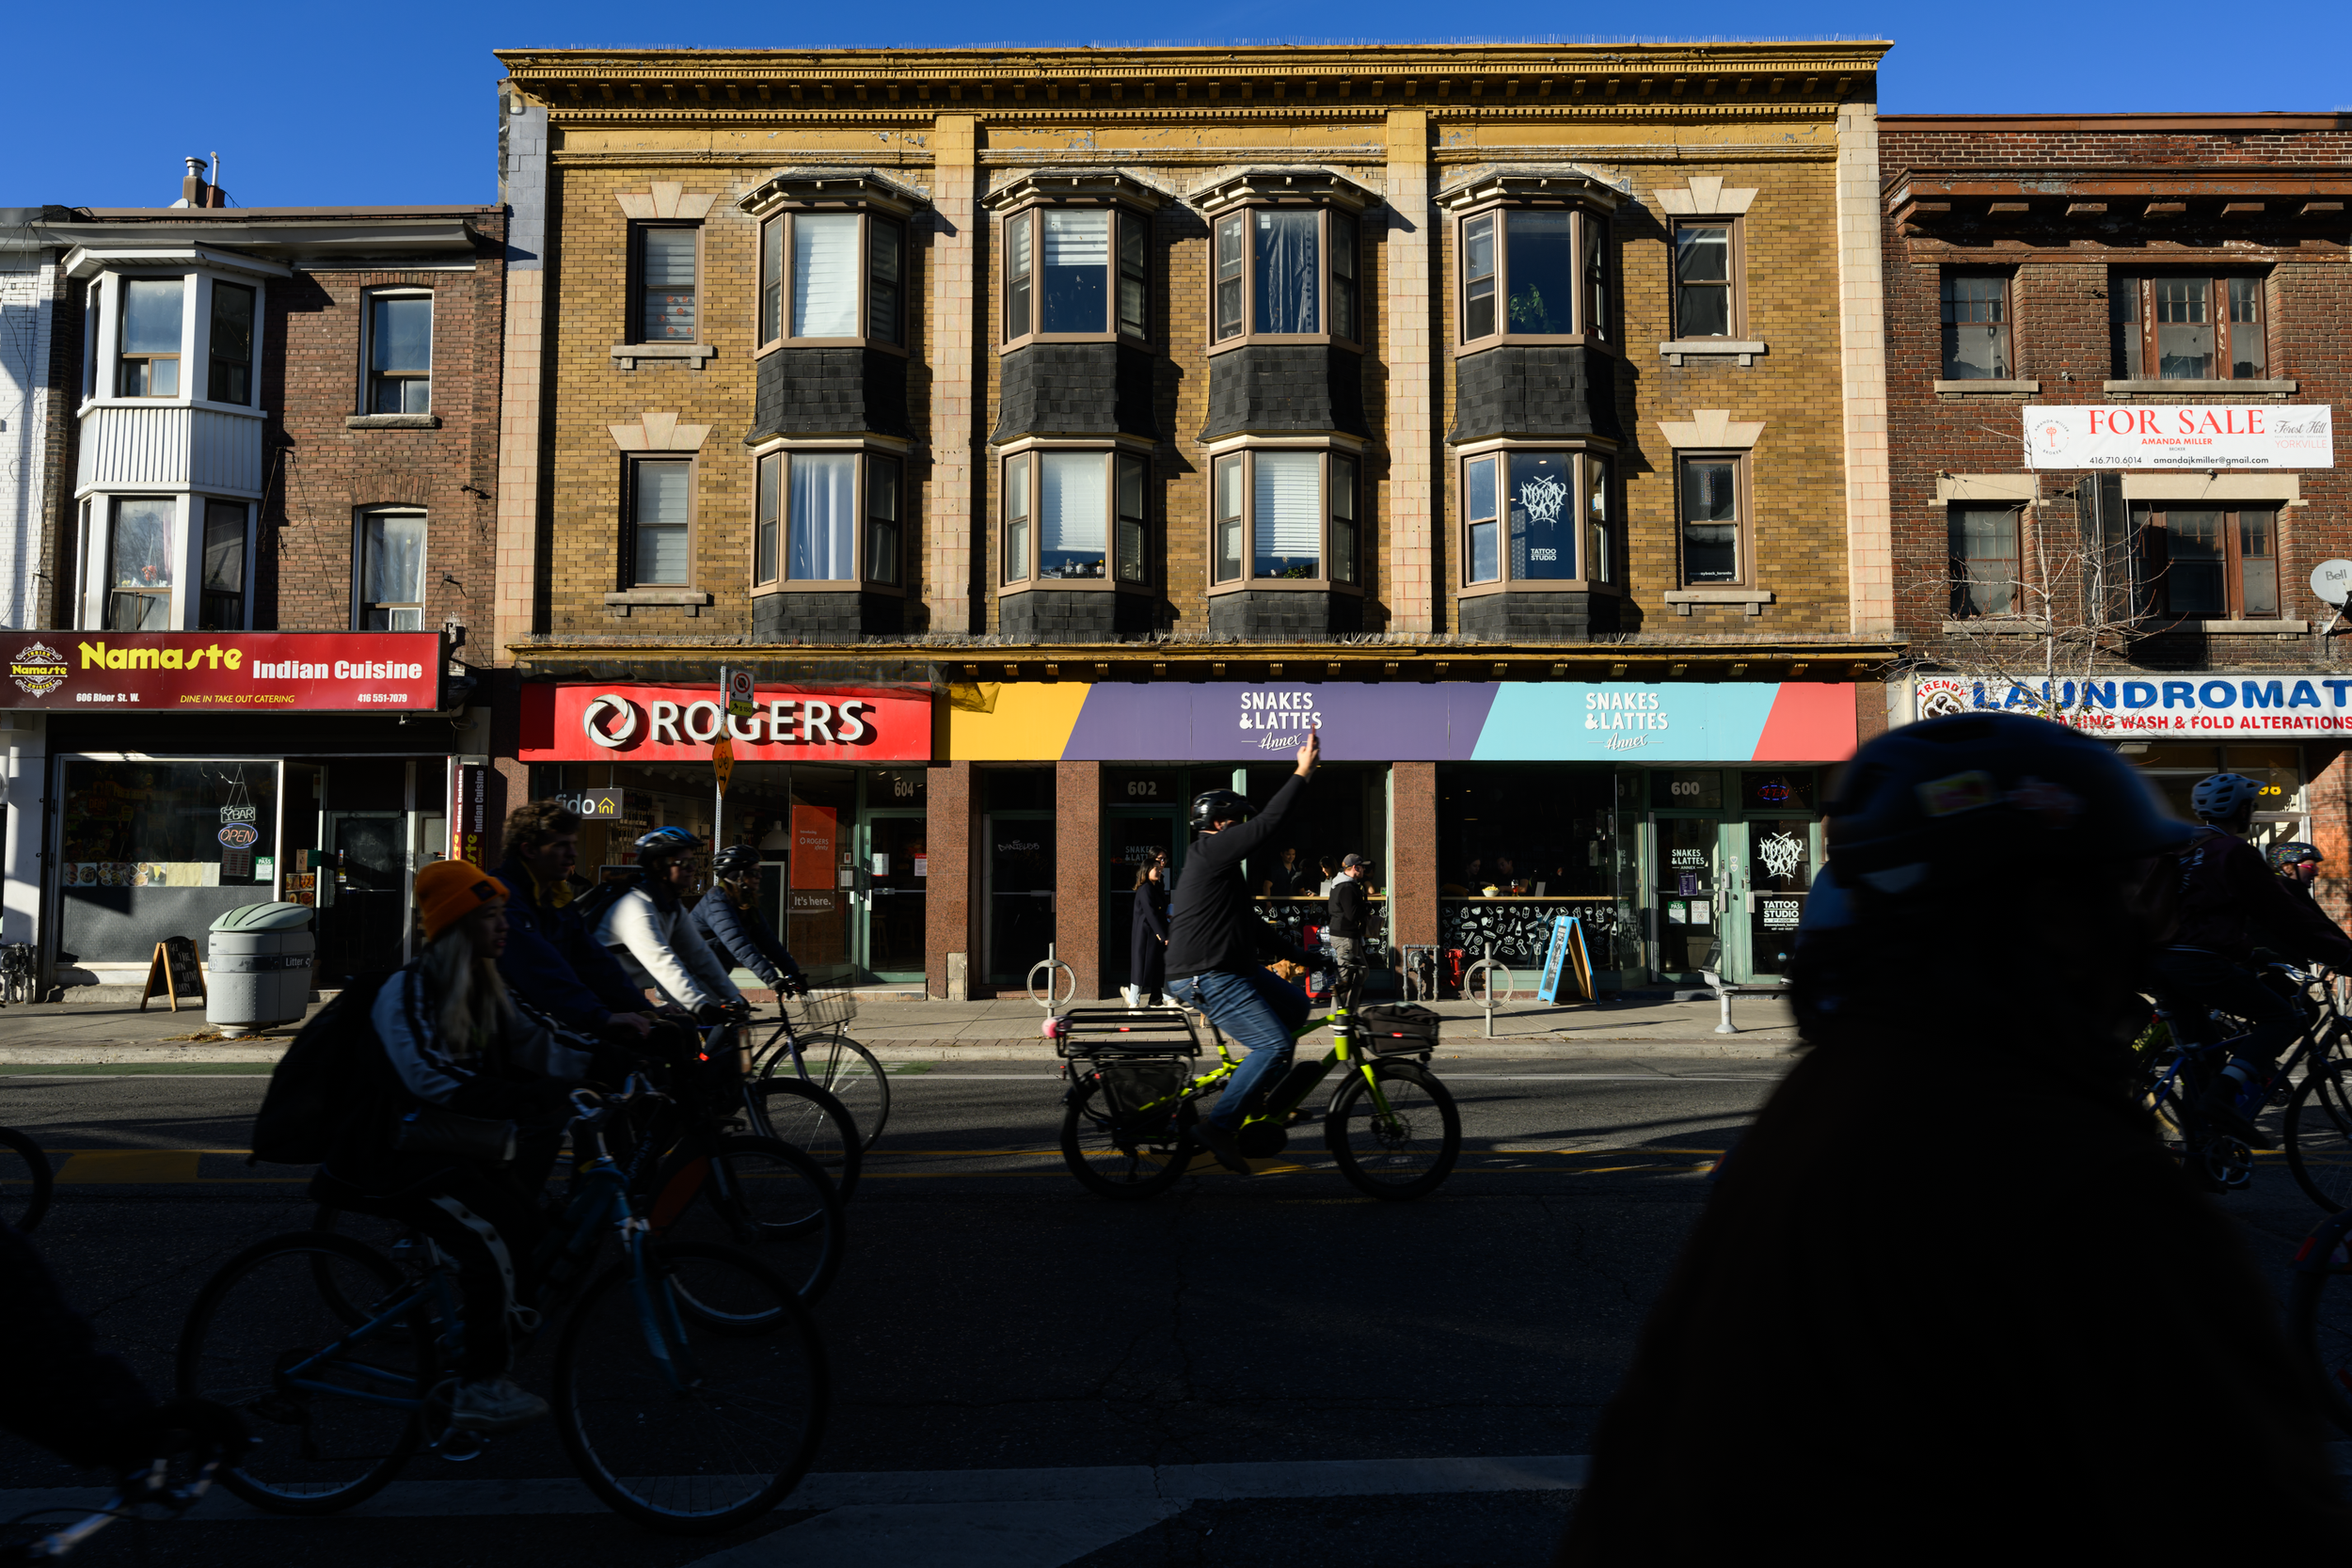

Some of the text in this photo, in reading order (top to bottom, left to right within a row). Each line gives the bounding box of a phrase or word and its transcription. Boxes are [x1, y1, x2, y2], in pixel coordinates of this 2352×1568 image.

[2034, 419, 2070, 433] AMANDA MILLER
[2088, 409, 2265, 435] FOR SALE
[2274, 420, 2328, 434] Forest Hill
[2275, 439, 2328, 449] YORKVILLE
[2089, 456, 2269, 466] 416.710.6014 amandajkmiller@gmail.com
[2326, 569, 2347, 580] Bell
[77, 641, 243, 671] Namaste
[11, 665, 67, 675] Namaste
[253, 660, 422, 679] Indian Cuisine
[1916, 680, 1967, 698] TRENDY
[1973, 680, 2352, 709] LAUNDROMAT
[75, 693, 140, 702] 606 Bloor St. W.
[180, 695, 295, 704] DINE IN TAKE OUT CATERING
[358, 693, 407, 703] 416 551-7079
[1241, 691, 1314, 710] SNAKES
[1585, 692, 1661, 710] SNAKES
[651, 700, 865, 741] ROGERS
[2121, 716, 2169, 729] WASH
[2174, 716, 2185, 729] &
[2191, 716, 2234, 729] FOLD
[2240, 716, 2352, 729] ALTERATIONS
[1258, 732, 1302, 751] Annex
[1604, 732, 1648, 751] Annex
[894, 781, 914, 798] 604
[1127, 781, 1157, 796] 602
[1670, 781, 1700, 796] 600
[1756, 788, 1790, 797] OPEN
[473, 769, 485, 832] Indian Cuisine
[232, 809, 254, 820] BAR
[220, 829, 255, 843] OPEN
[1124, 845, 1151, 854] SNAKE
[1671, 848, 1701, 857] SNAKES
[1124, 853, 1149, 862] &LATT
[794, 895, 832, 906] It's here.
[1762, 900, 1799, 909] TATTOO
[1763, 910, 1799, 918] STUDIO
[285, 958, 304, 967] Litter
[627, 1139, 653, 1180] gerine
